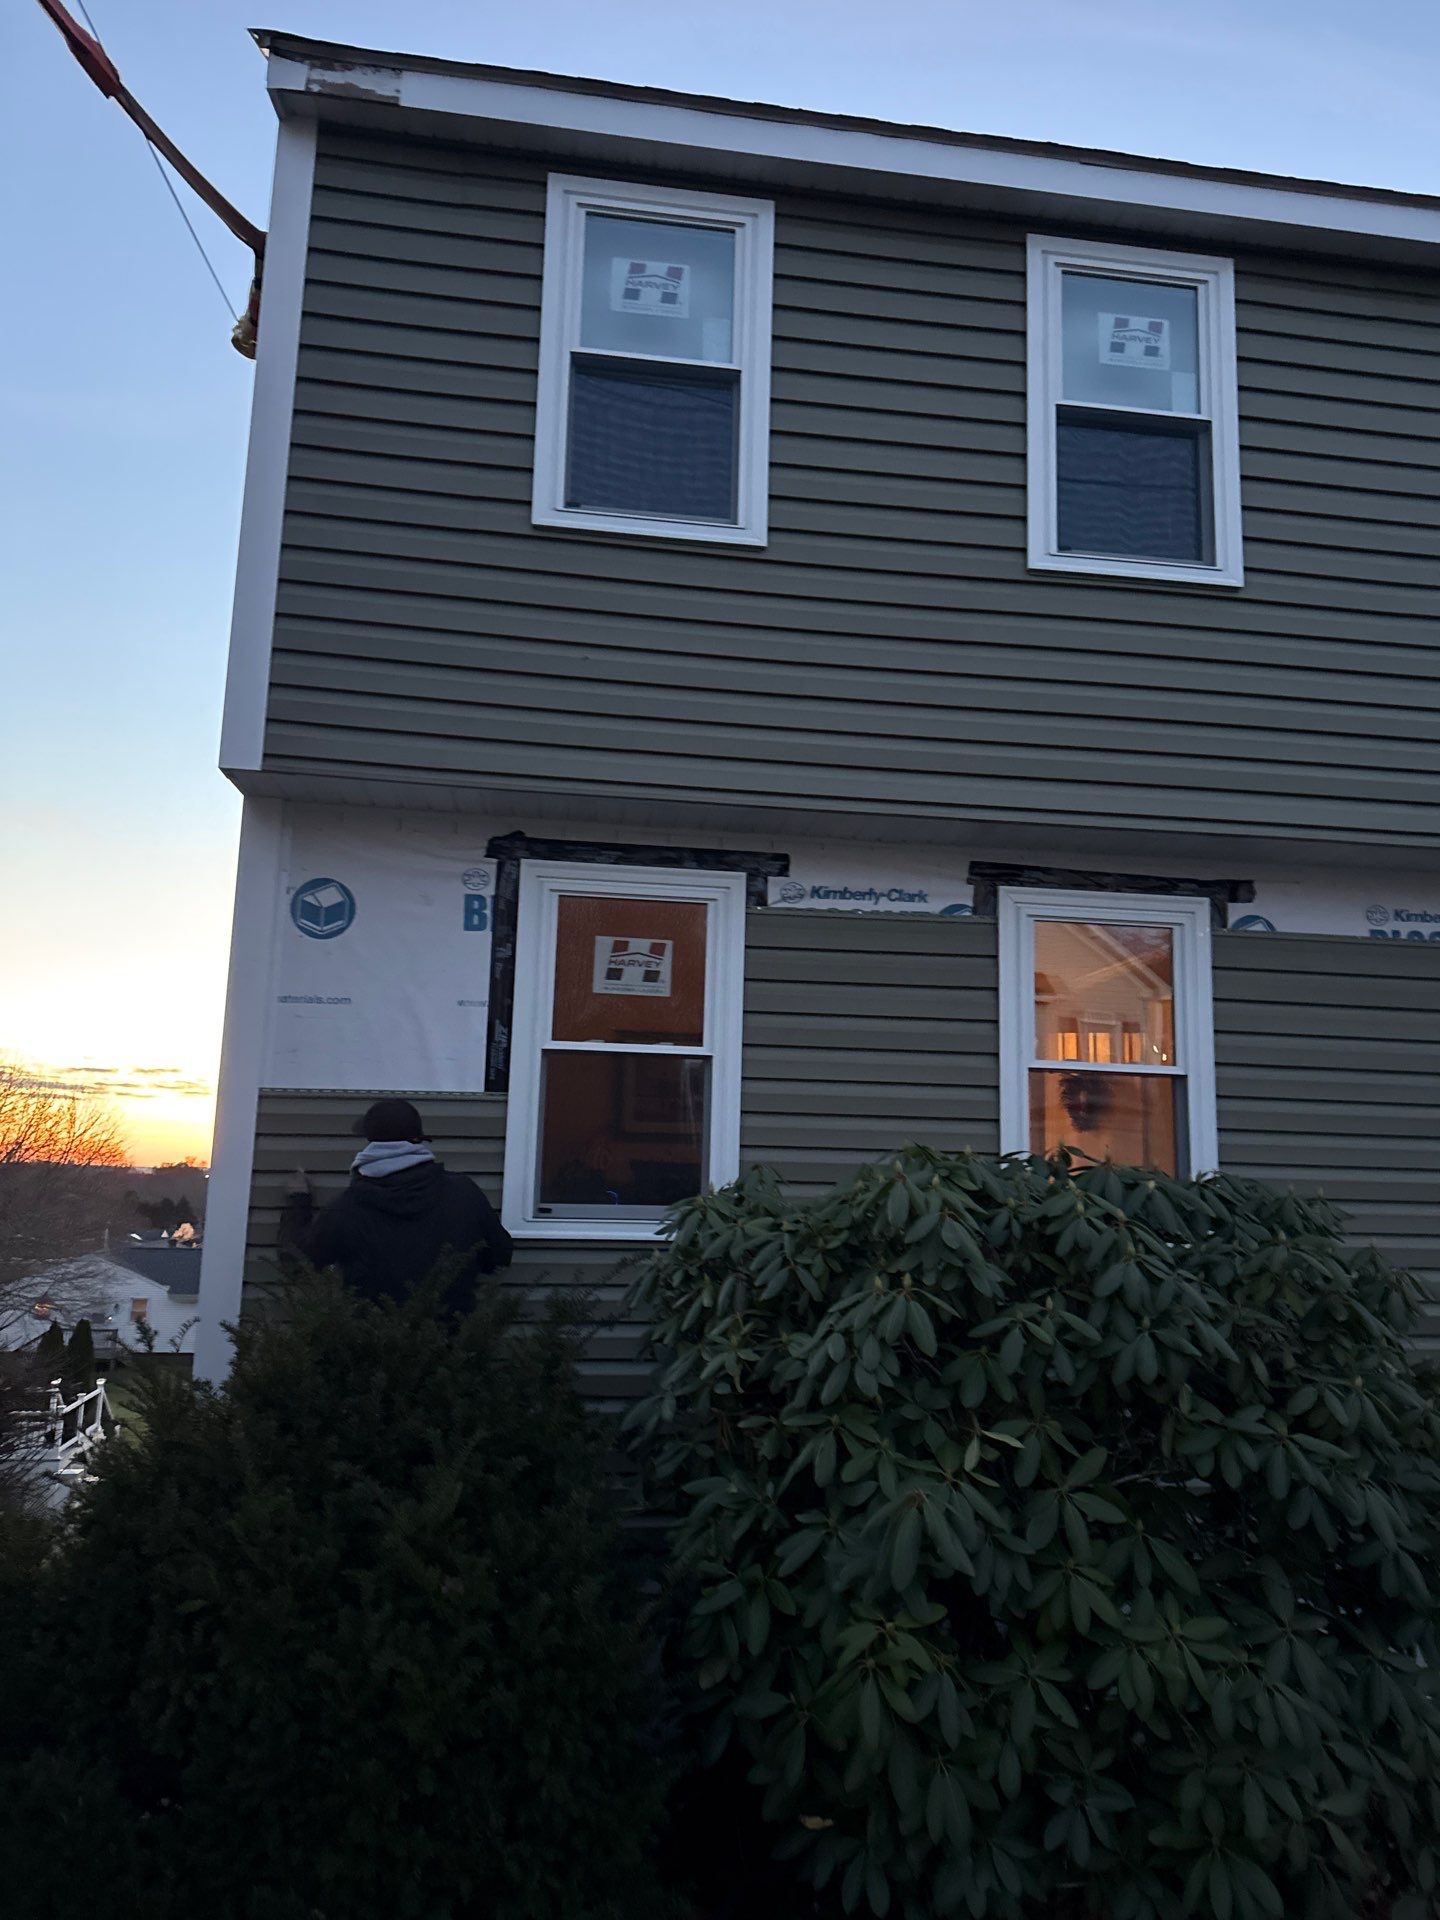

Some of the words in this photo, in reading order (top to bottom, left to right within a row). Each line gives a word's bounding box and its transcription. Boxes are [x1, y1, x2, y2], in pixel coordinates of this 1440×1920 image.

[625, 280, 680, 290] HARVEY
[1112, 333, 1160, 343] HARVEY
[810, 886, 928, 905] Kimberly-Clark
[608, 958, 661, 968] HARVEY
